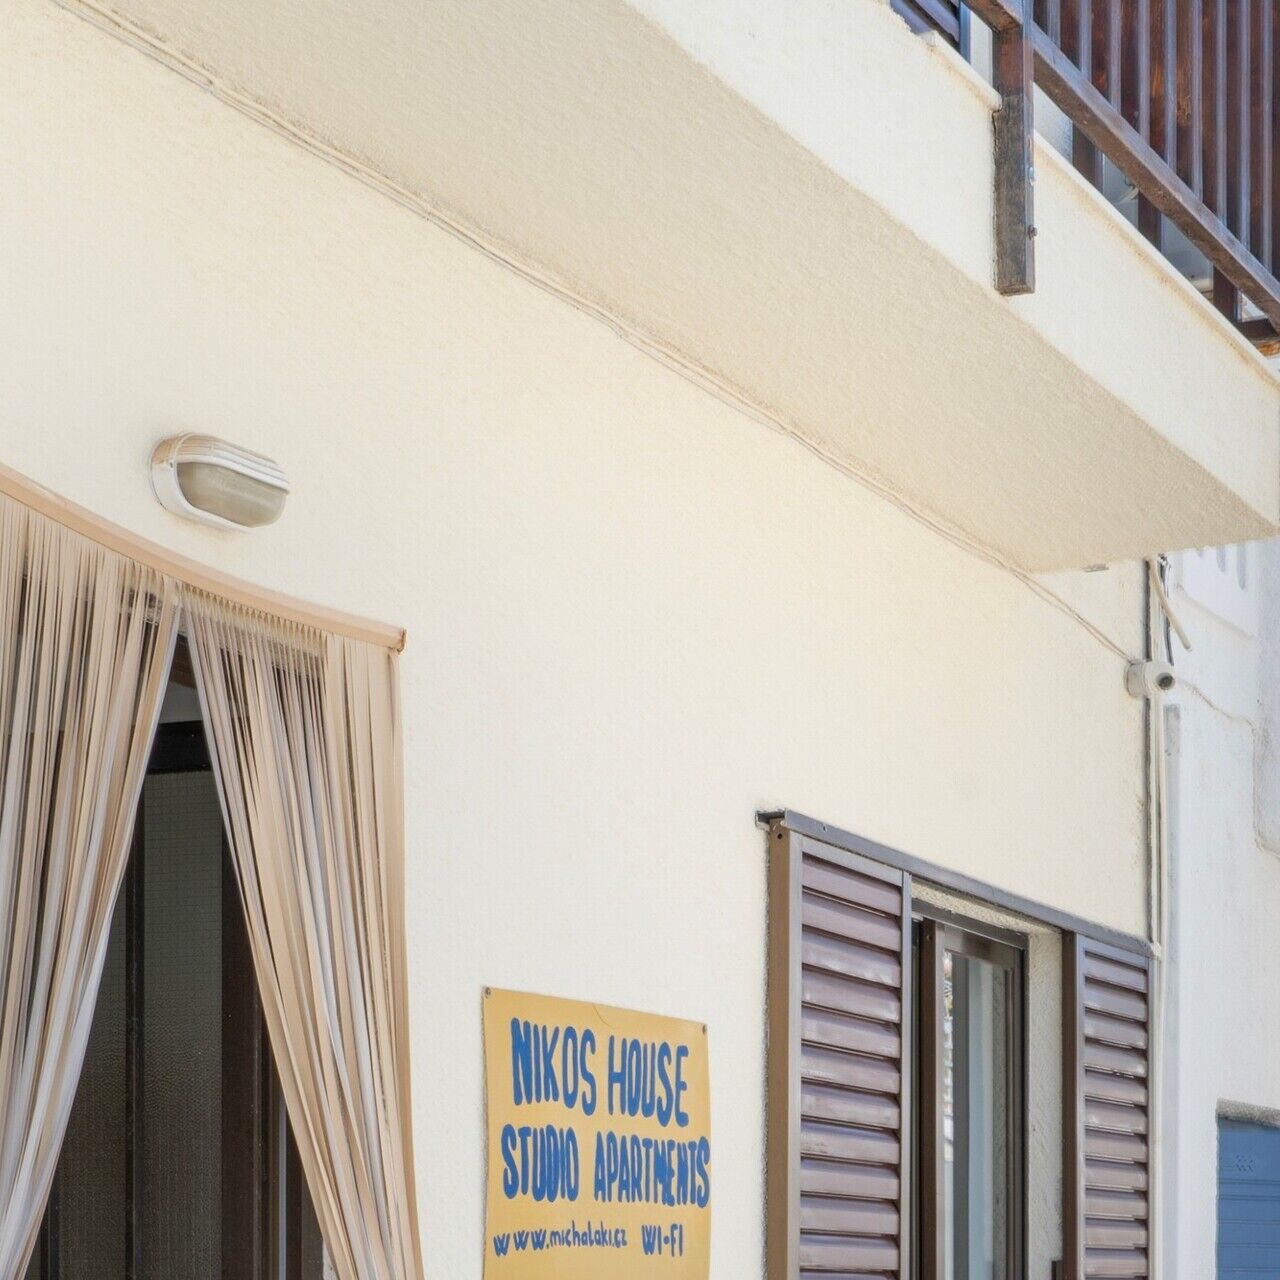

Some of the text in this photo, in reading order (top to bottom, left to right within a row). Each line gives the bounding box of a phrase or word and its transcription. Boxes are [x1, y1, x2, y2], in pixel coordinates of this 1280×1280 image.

[511, 1017, 689, 1128] NIKOS HOUSE
[501, 1123, 710, 1209] STUDIO APARTMENTS
